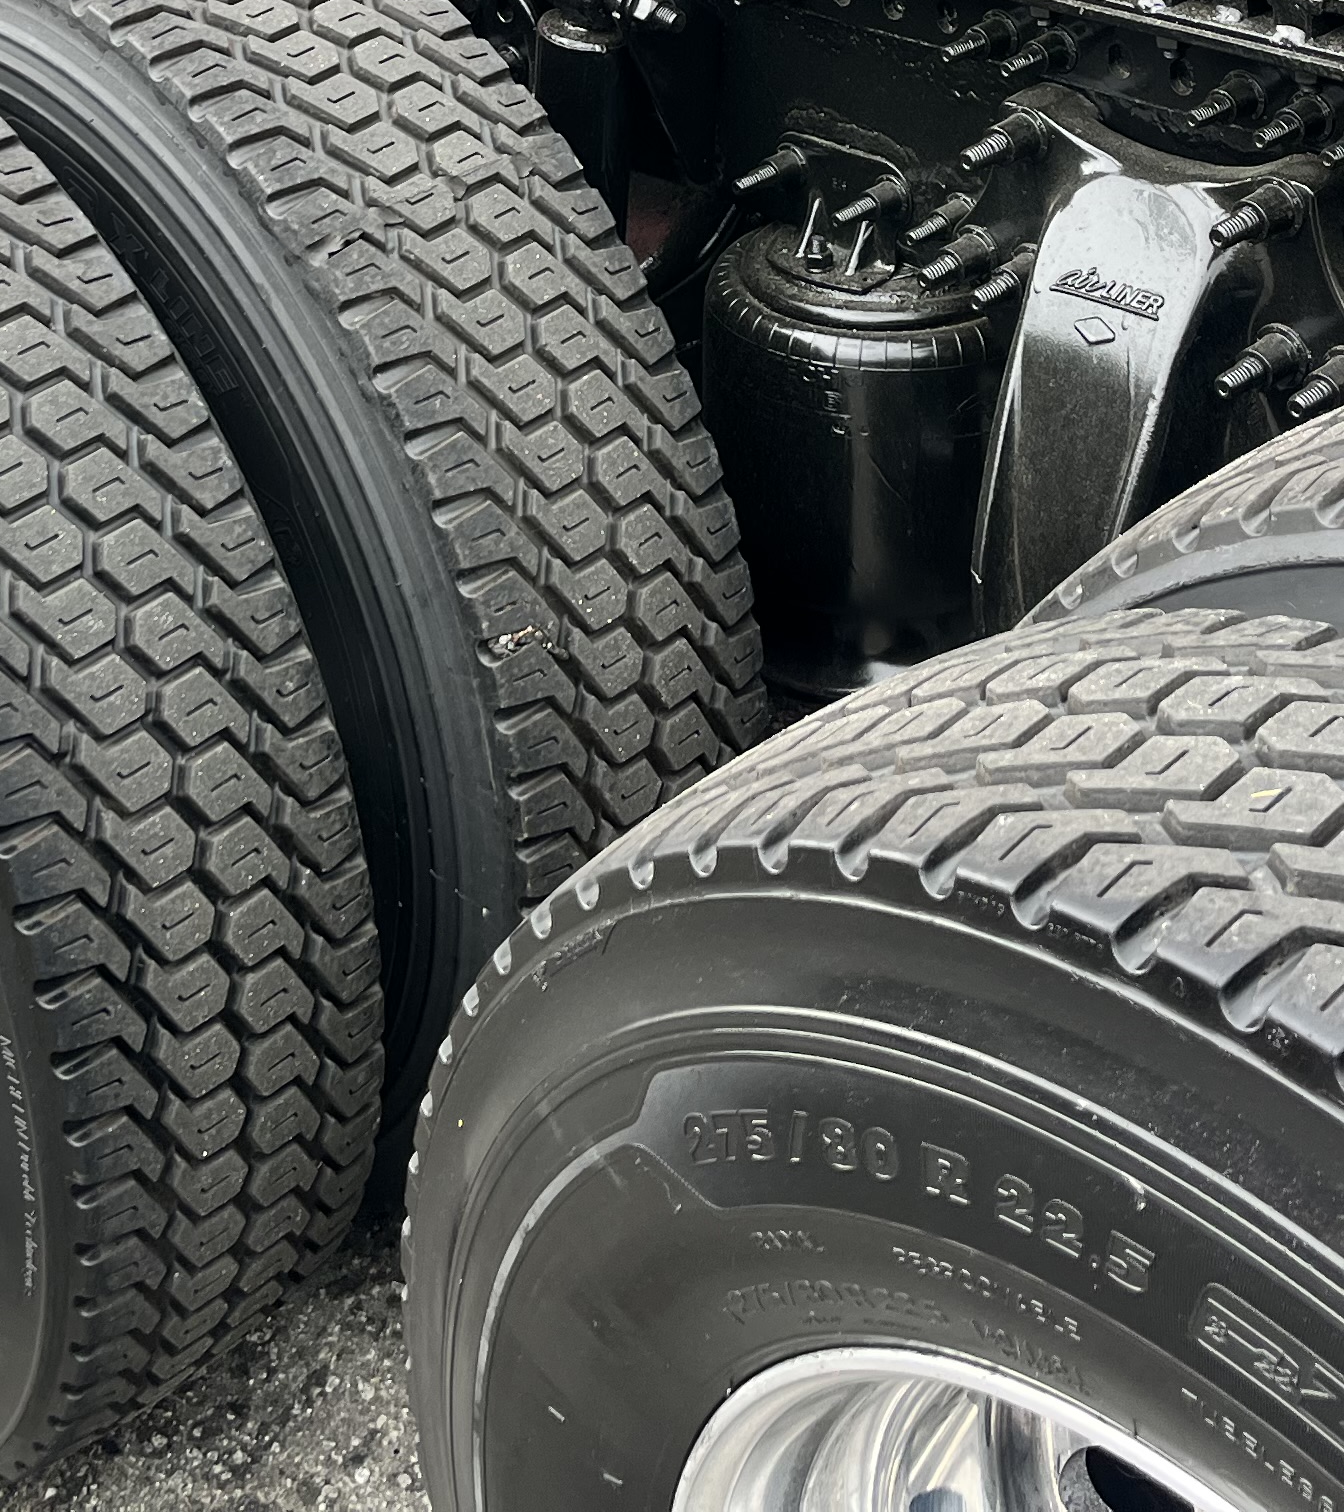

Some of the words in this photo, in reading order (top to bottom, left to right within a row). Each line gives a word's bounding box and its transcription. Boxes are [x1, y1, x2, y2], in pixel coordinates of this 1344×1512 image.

[140, 267, 238, 394] LINE
[683, 1109, 900, 1182] 275/80
[920, 1140, 971, 1206] R
[993, 1172, 1156, 1294] 22.5
